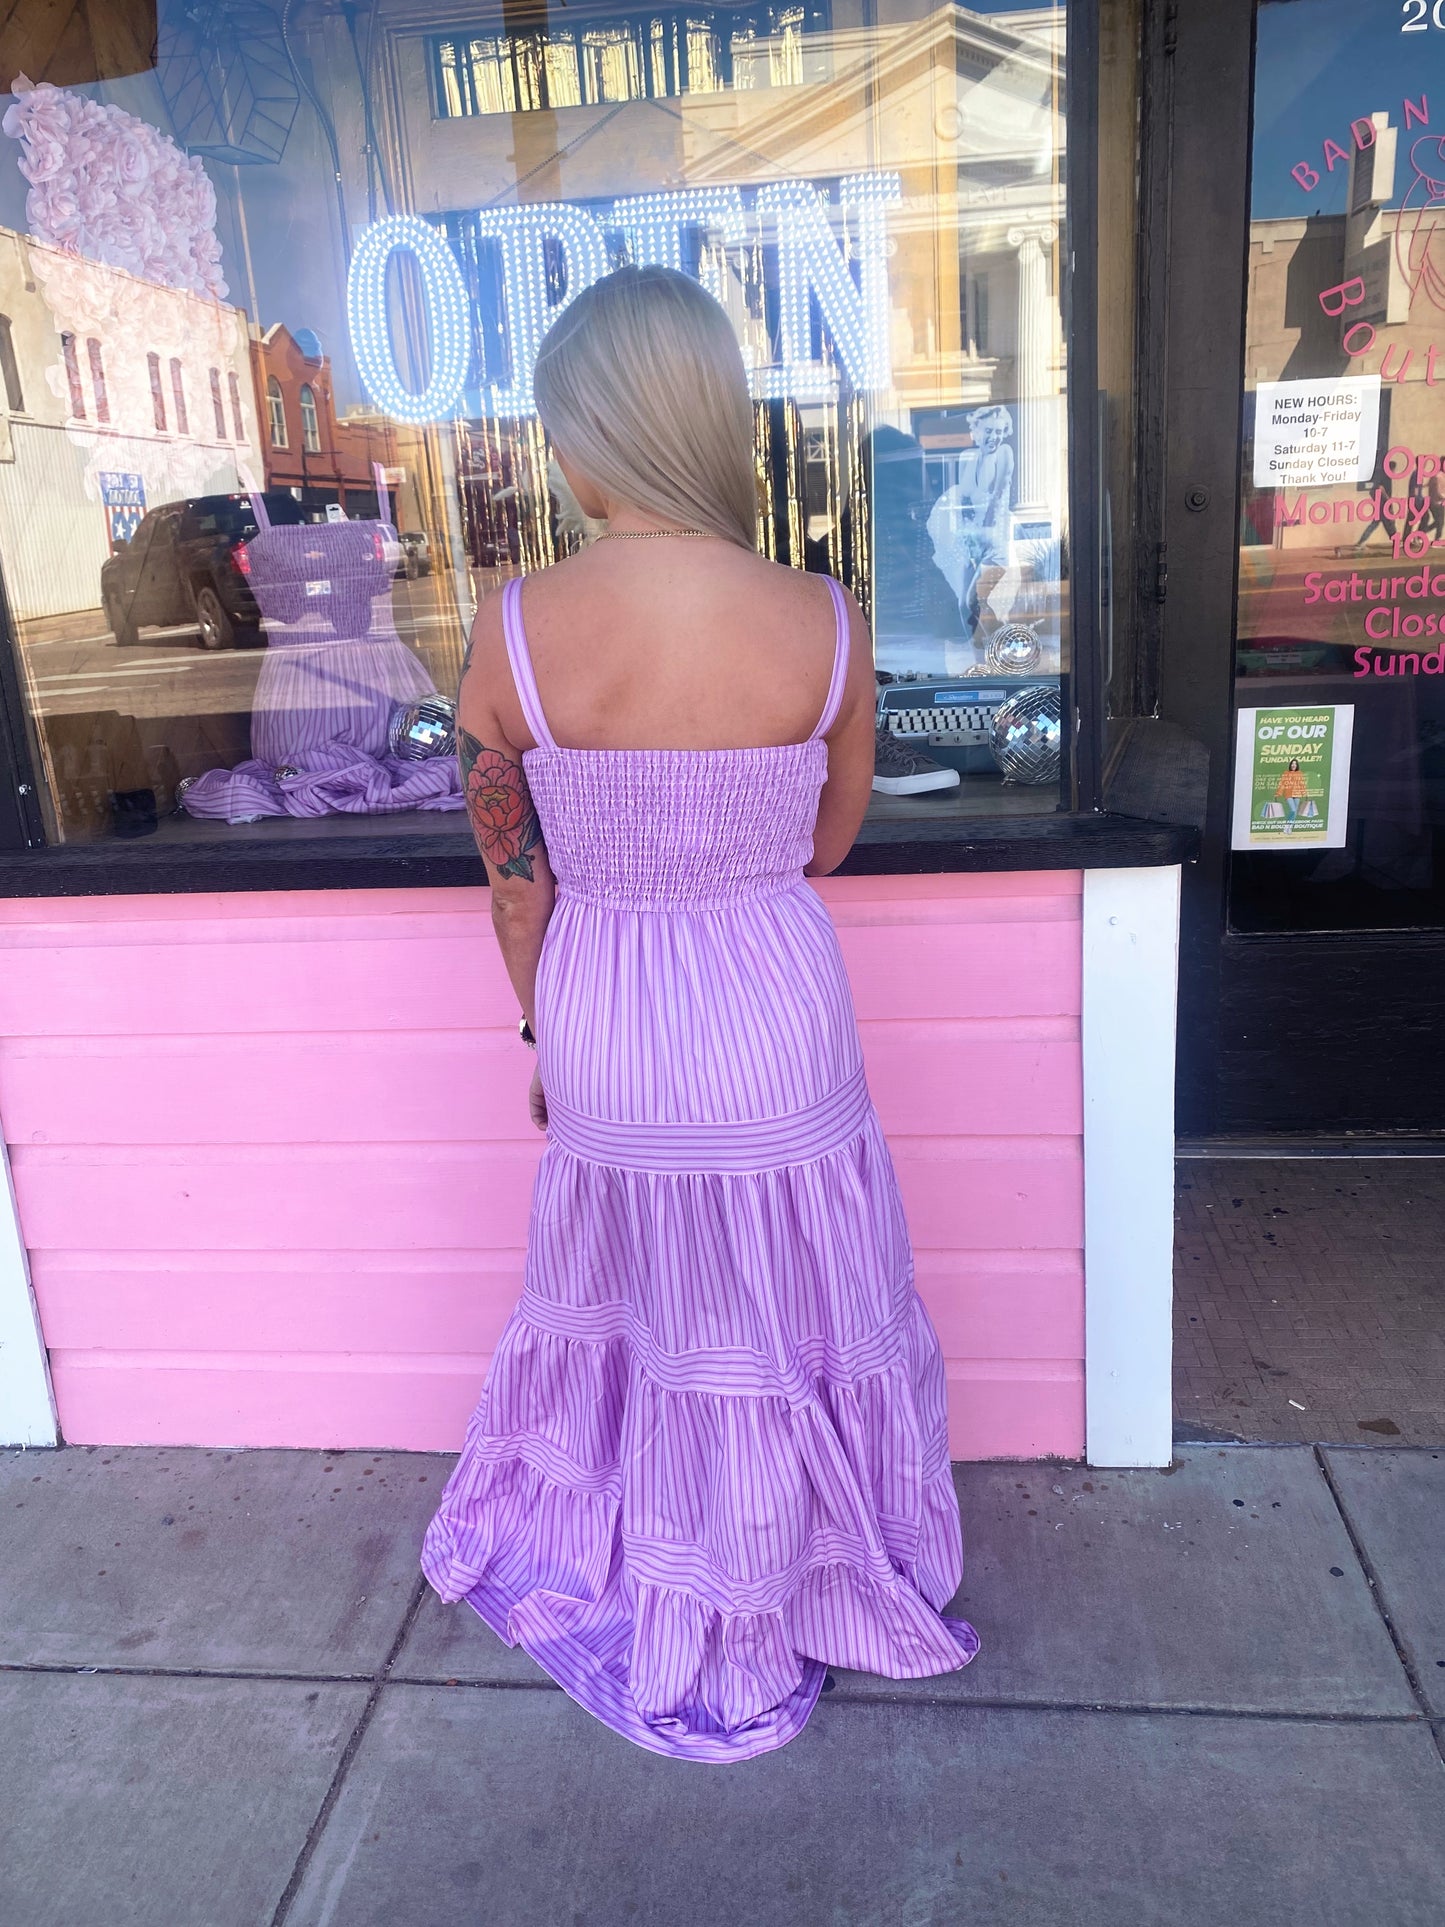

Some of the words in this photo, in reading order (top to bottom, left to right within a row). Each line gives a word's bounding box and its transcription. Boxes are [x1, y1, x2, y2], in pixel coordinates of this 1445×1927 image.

[1291, 116, 1377, 192] BAD
[1403, 94, 1429, 130] N
[1274, 397, 1304, 410] NEW
[1307, 394, 1358, 407] HOURS:
[1271, 410, 1362, 425] Monday-Friday
[1303, 427, 1329, 438] 10-7
[1274, 443, 1328, 455] Saturday
[1332, 440, 1356, 452] 11-7
[1269, 459, 1314, 471] Sunday
[1317, 455, 1359, 468] Closed
[1383, 446, 1445, 485] Op
[1280, 472, 1317, 485] Thank
[1320, 471, 1347, 482] You!
[1273, 488, 1431, 527] Monday
[1302, 715, 1330, 723] HEARD
[1258, 726, 1285, 740] OF
[1287, 724, 1327, 739] OUR
[1260, 743, 1323, 755] SUNDAY
